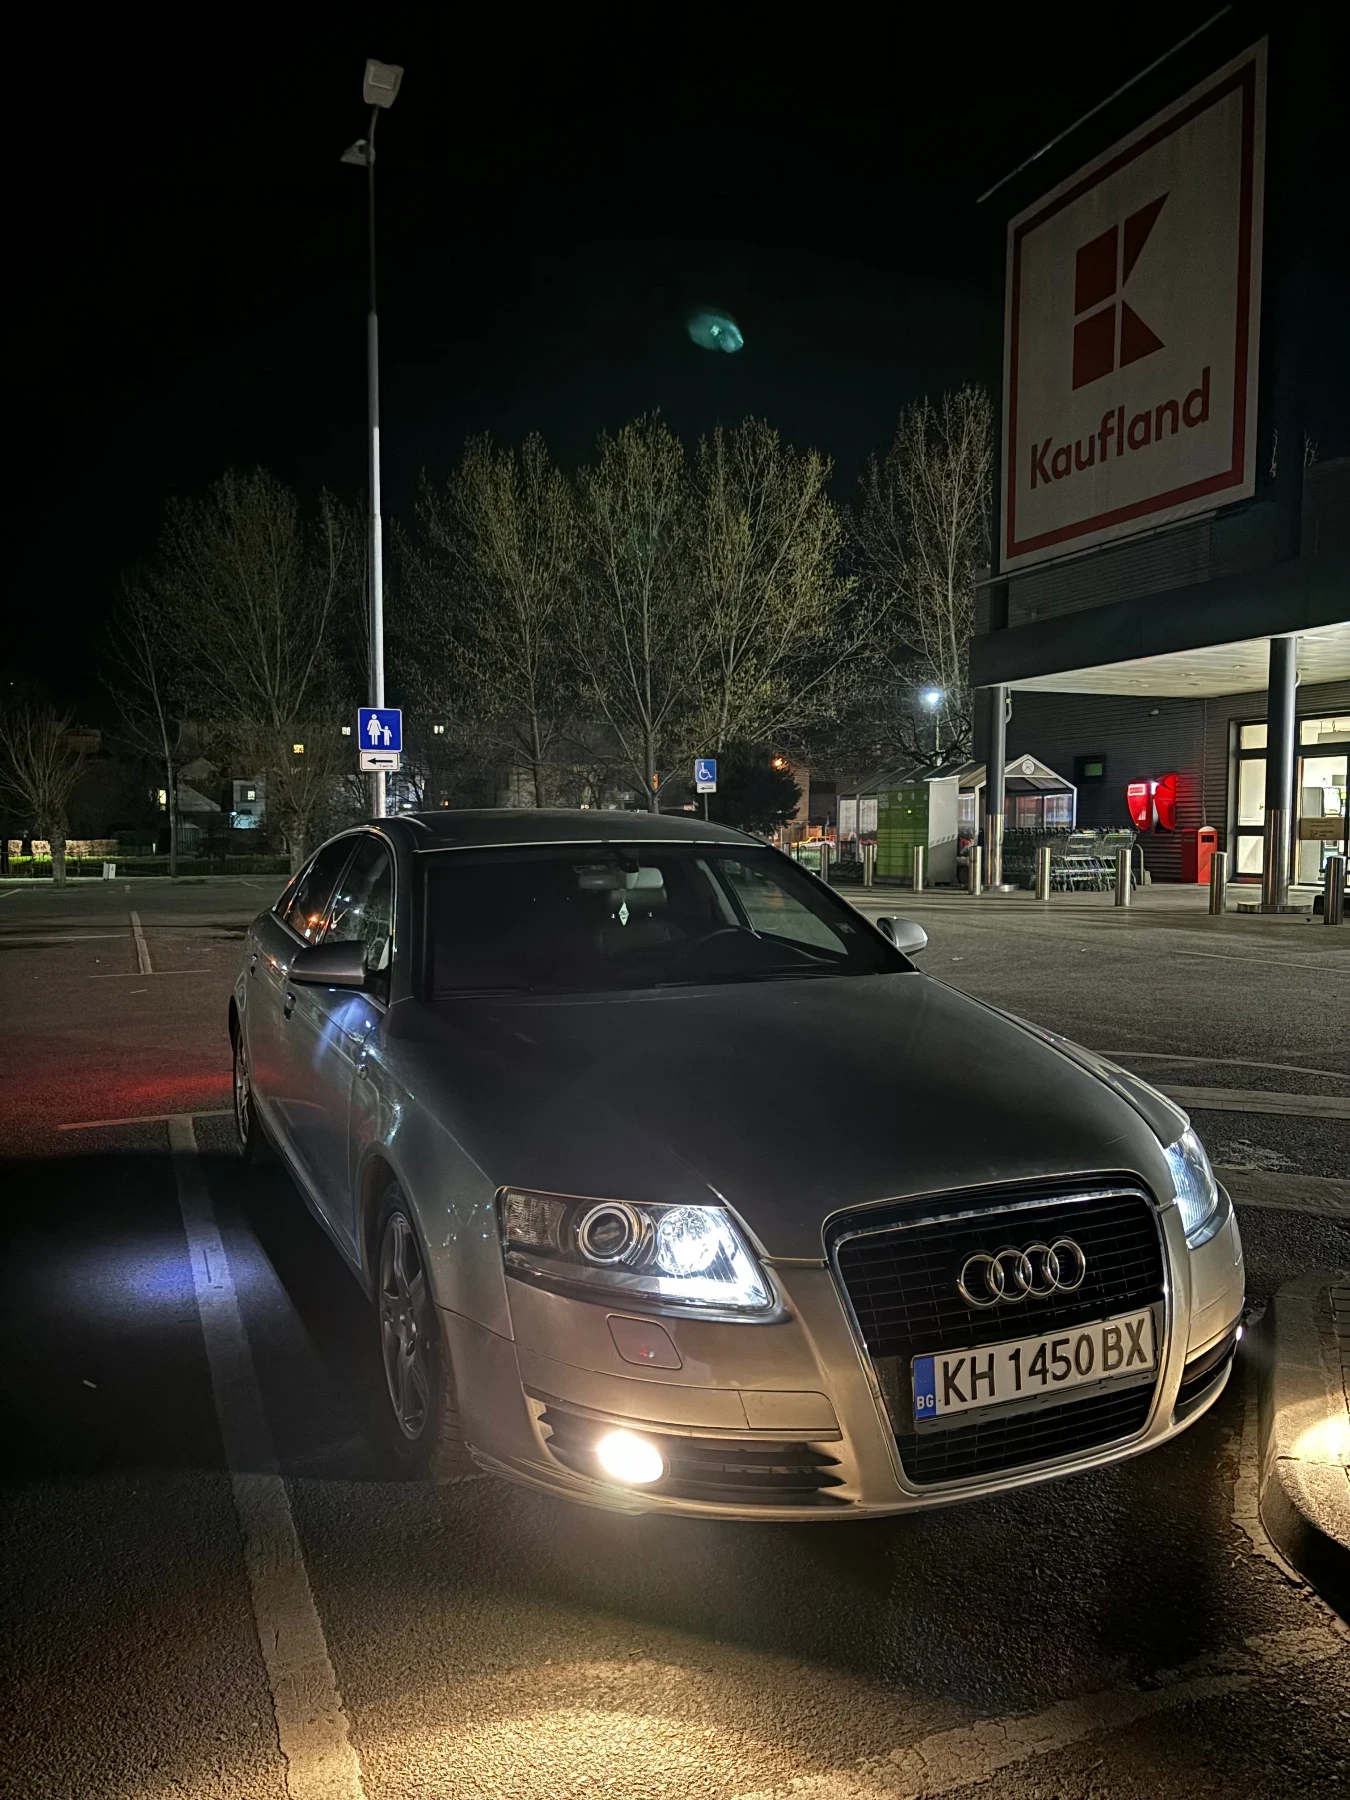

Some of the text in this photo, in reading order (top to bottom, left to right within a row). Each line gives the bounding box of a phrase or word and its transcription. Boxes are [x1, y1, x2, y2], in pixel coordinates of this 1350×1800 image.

[1030, 366, 1211, 489] Kaufland
[916, 1394, 934, 1410] BG
[942, 1317, 1148, 1406] KH 1450 BX
